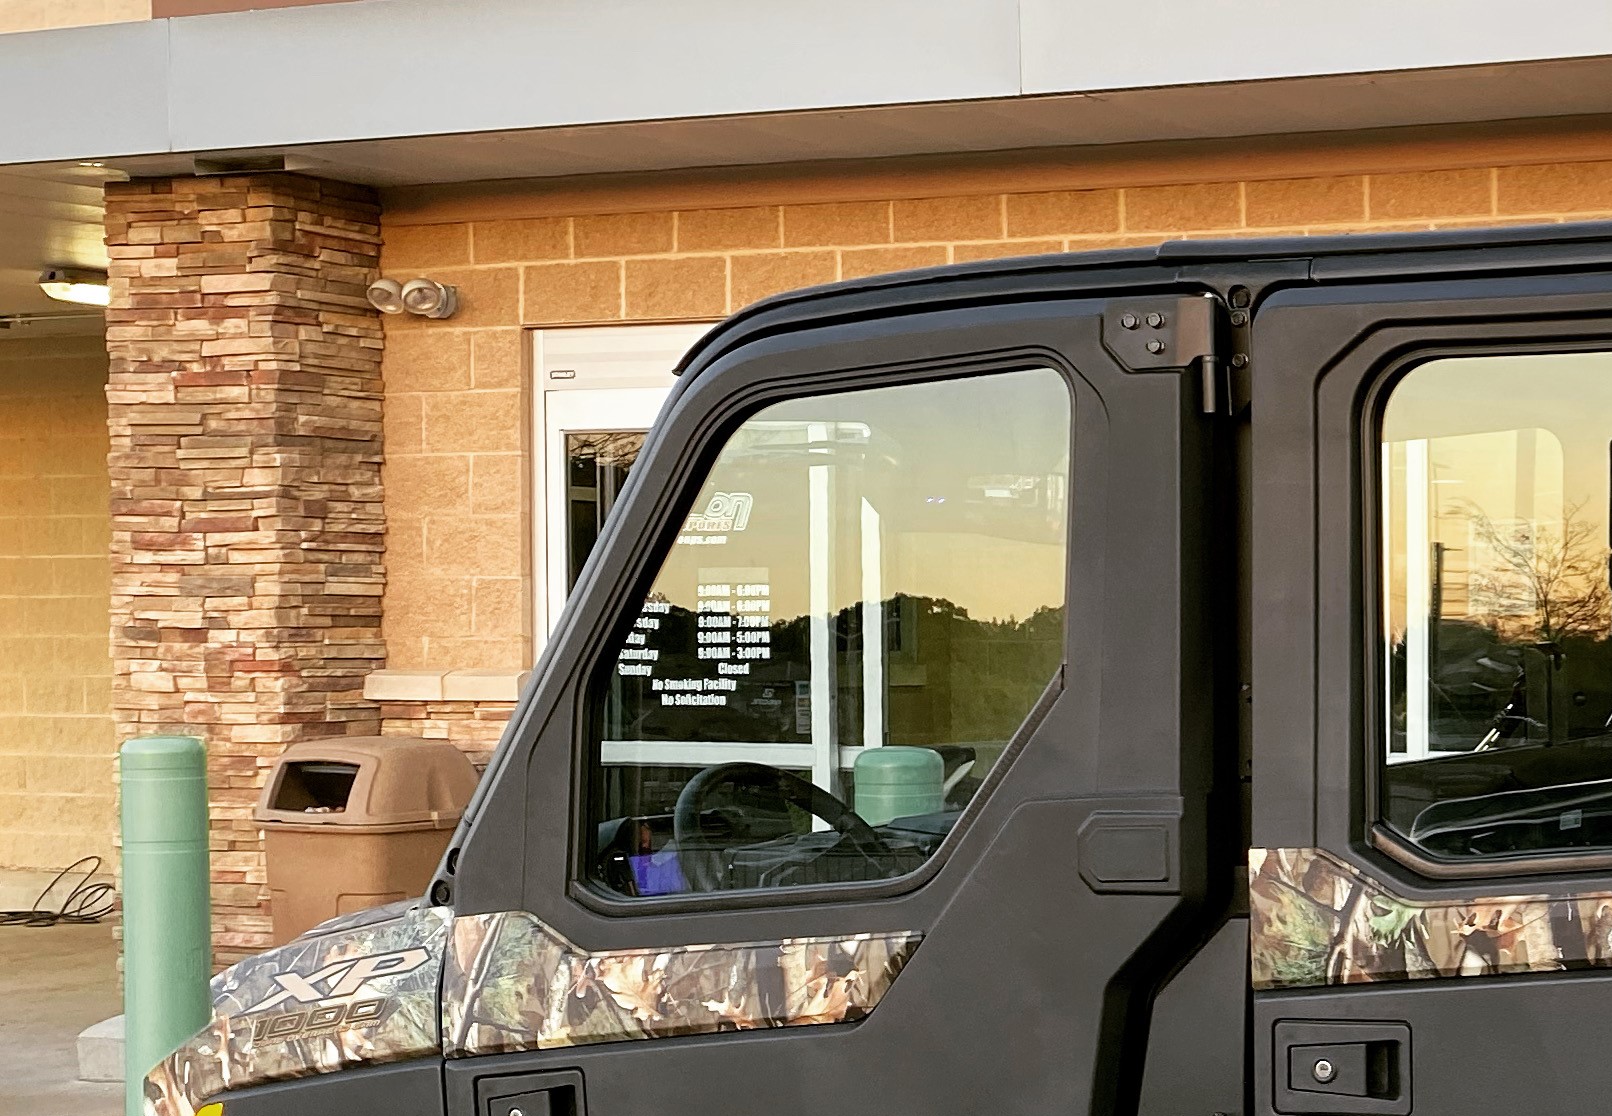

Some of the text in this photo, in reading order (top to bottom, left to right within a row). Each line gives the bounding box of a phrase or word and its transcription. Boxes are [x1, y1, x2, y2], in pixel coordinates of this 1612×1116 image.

[682, 520, 733, 532] PORTS
[618, 662, 750, 676] Sunday Closed
[664, 679, 702, 691] Smoking
[704, 678, 737, 691] Facility
[661, 694, 727, 706] No Solicitation
[231, 946, 432, 1020] XP
[253, 998, 387, 1042] 1000
